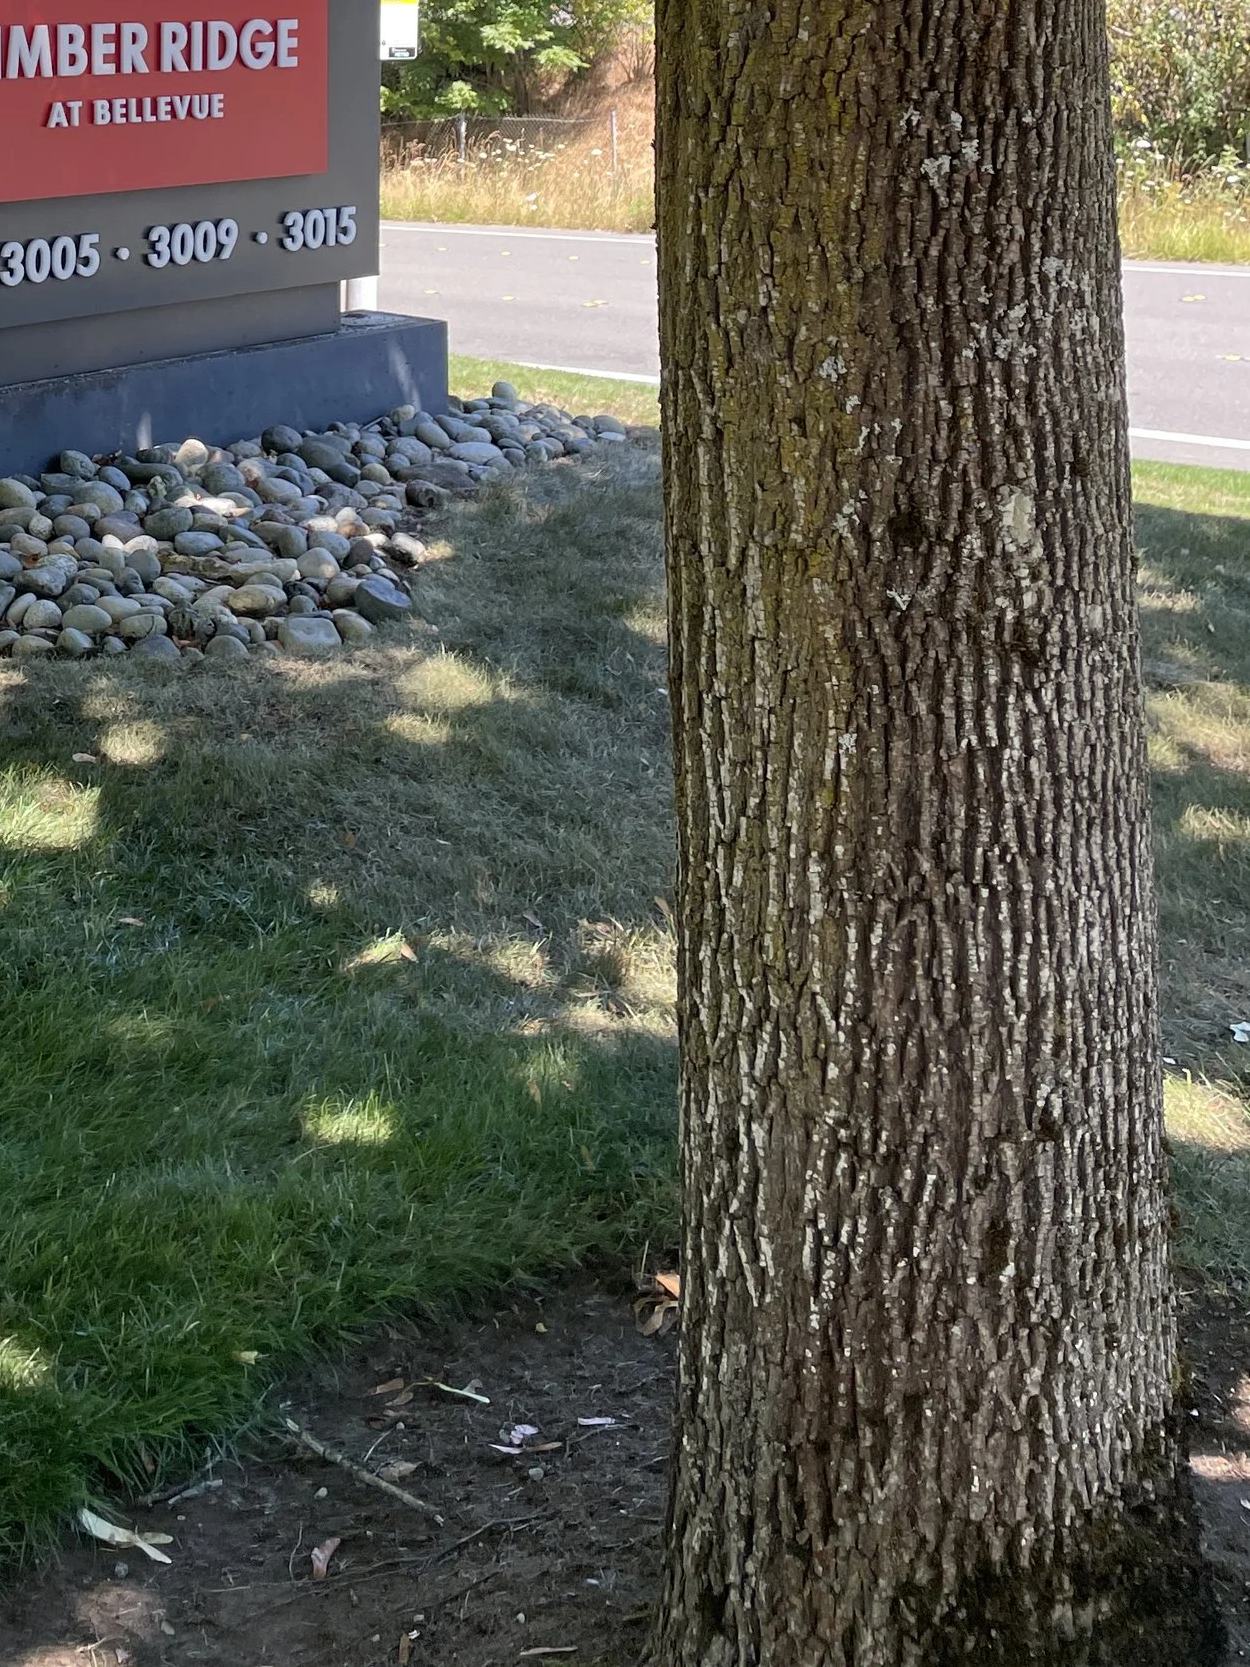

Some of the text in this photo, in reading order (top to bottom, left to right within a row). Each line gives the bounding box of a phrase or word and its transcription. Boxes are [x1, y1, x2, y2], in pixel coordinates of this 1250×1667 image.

[160, 18, 299, 73] RIDGE
[47, 94, 224, 129] AT BELLEVUE
[0, 233, 100, 287] 3005
[148, 218, 239, 269] 3009
[283, 206, 358, 253] 3015
